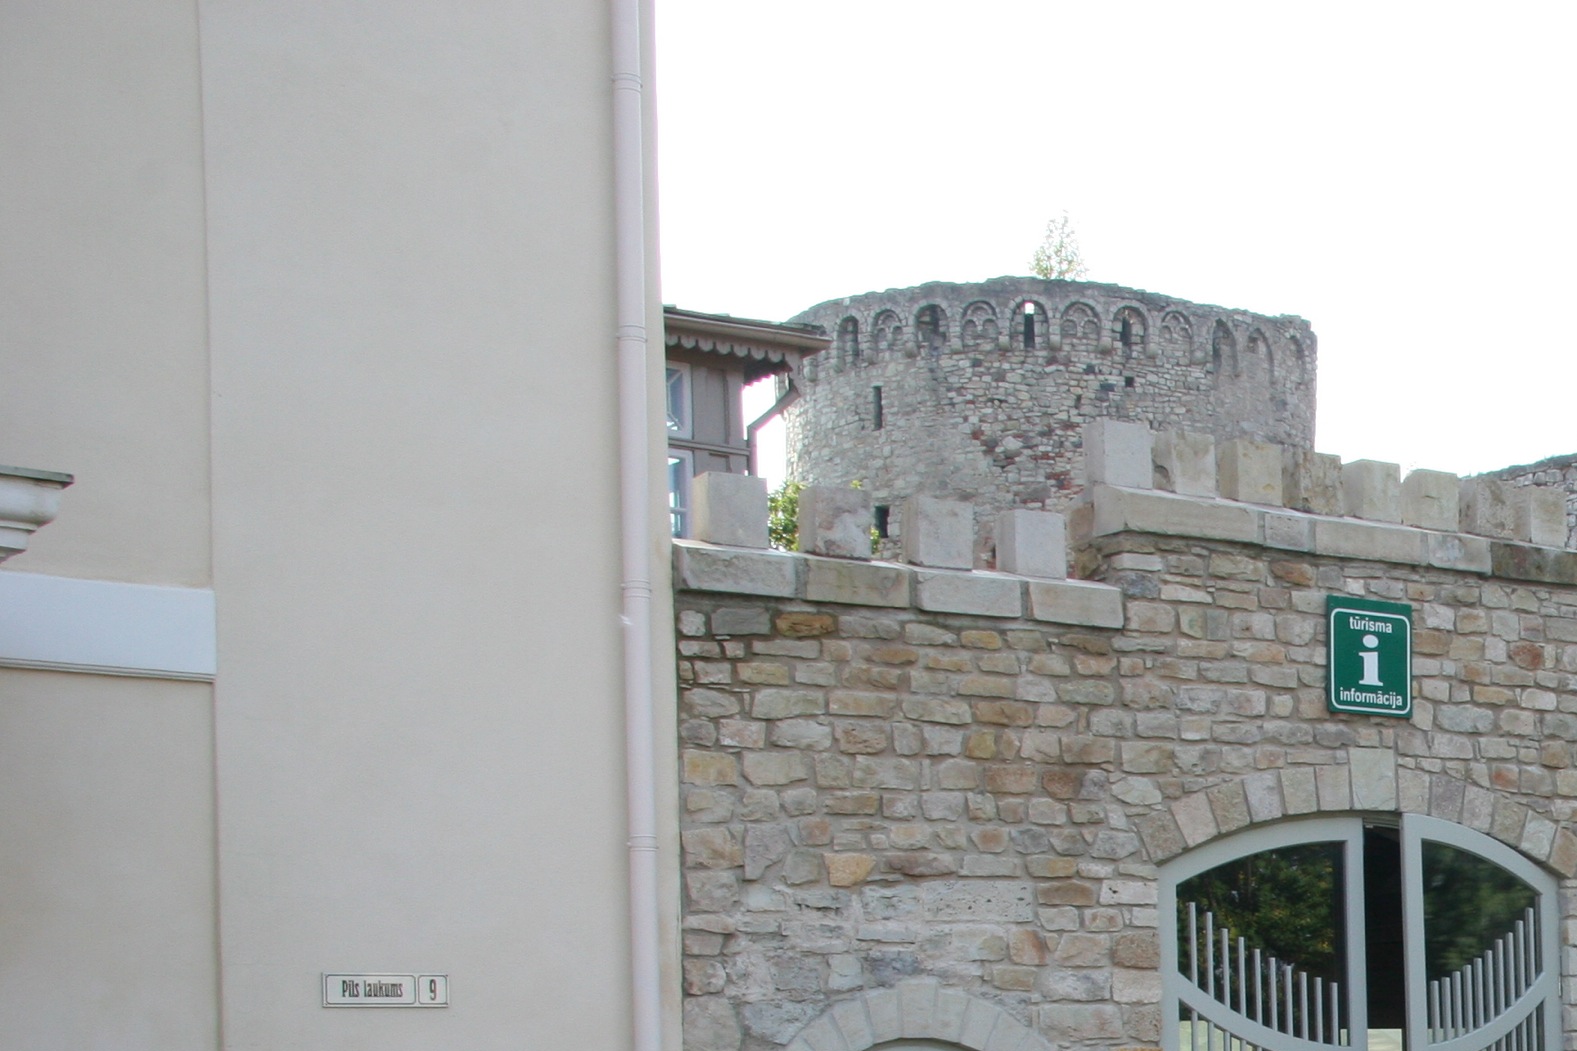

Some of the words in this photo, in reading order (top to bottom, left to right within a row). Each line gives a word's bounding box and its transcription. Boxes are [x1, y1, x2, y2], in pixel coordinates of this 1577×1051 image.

[1349, 616, 1392, 633] tūrisma
[1340, 687, 1403, 708] informācija
[342, 980, 360, 998] Pils
[363, 980, 403, 998] laukums
[429, 979, 437, 1000] 9
